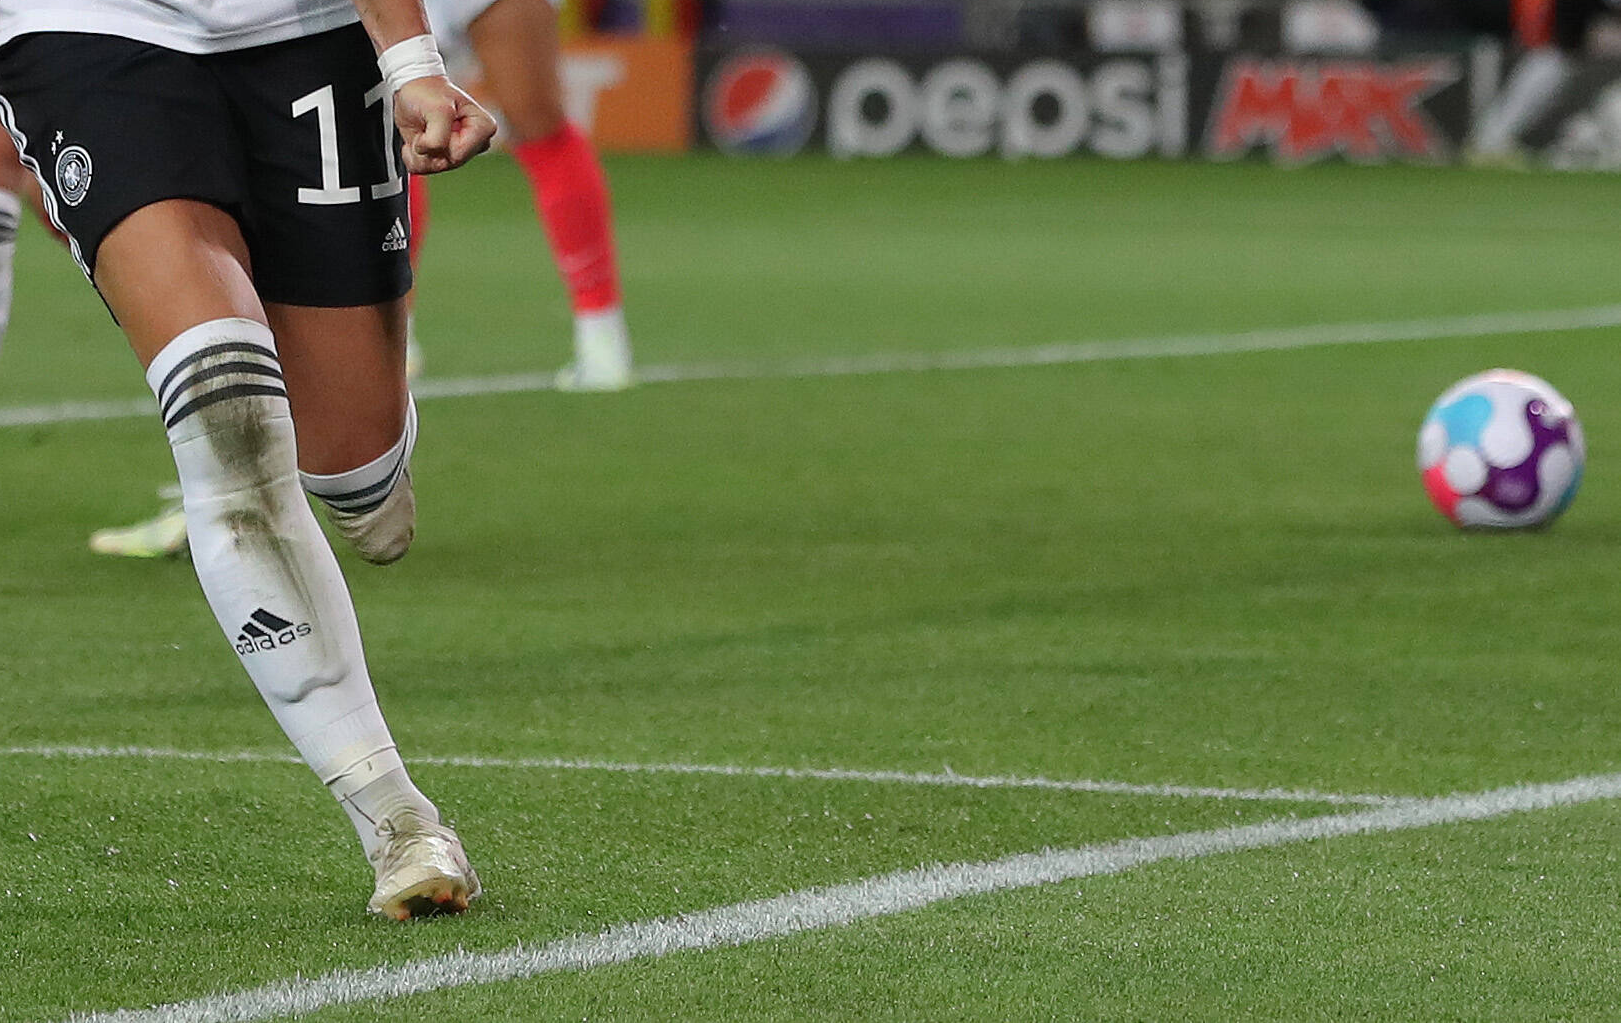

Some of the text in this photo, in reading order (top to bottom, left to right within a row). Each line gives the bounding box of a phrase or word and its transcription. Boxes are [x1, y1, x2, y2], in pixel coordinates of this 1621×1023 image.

[291, 84, 403, 205] 11
[829, 51, 1189, 159] pepsi
[236, 622, 312, 656] adidas
